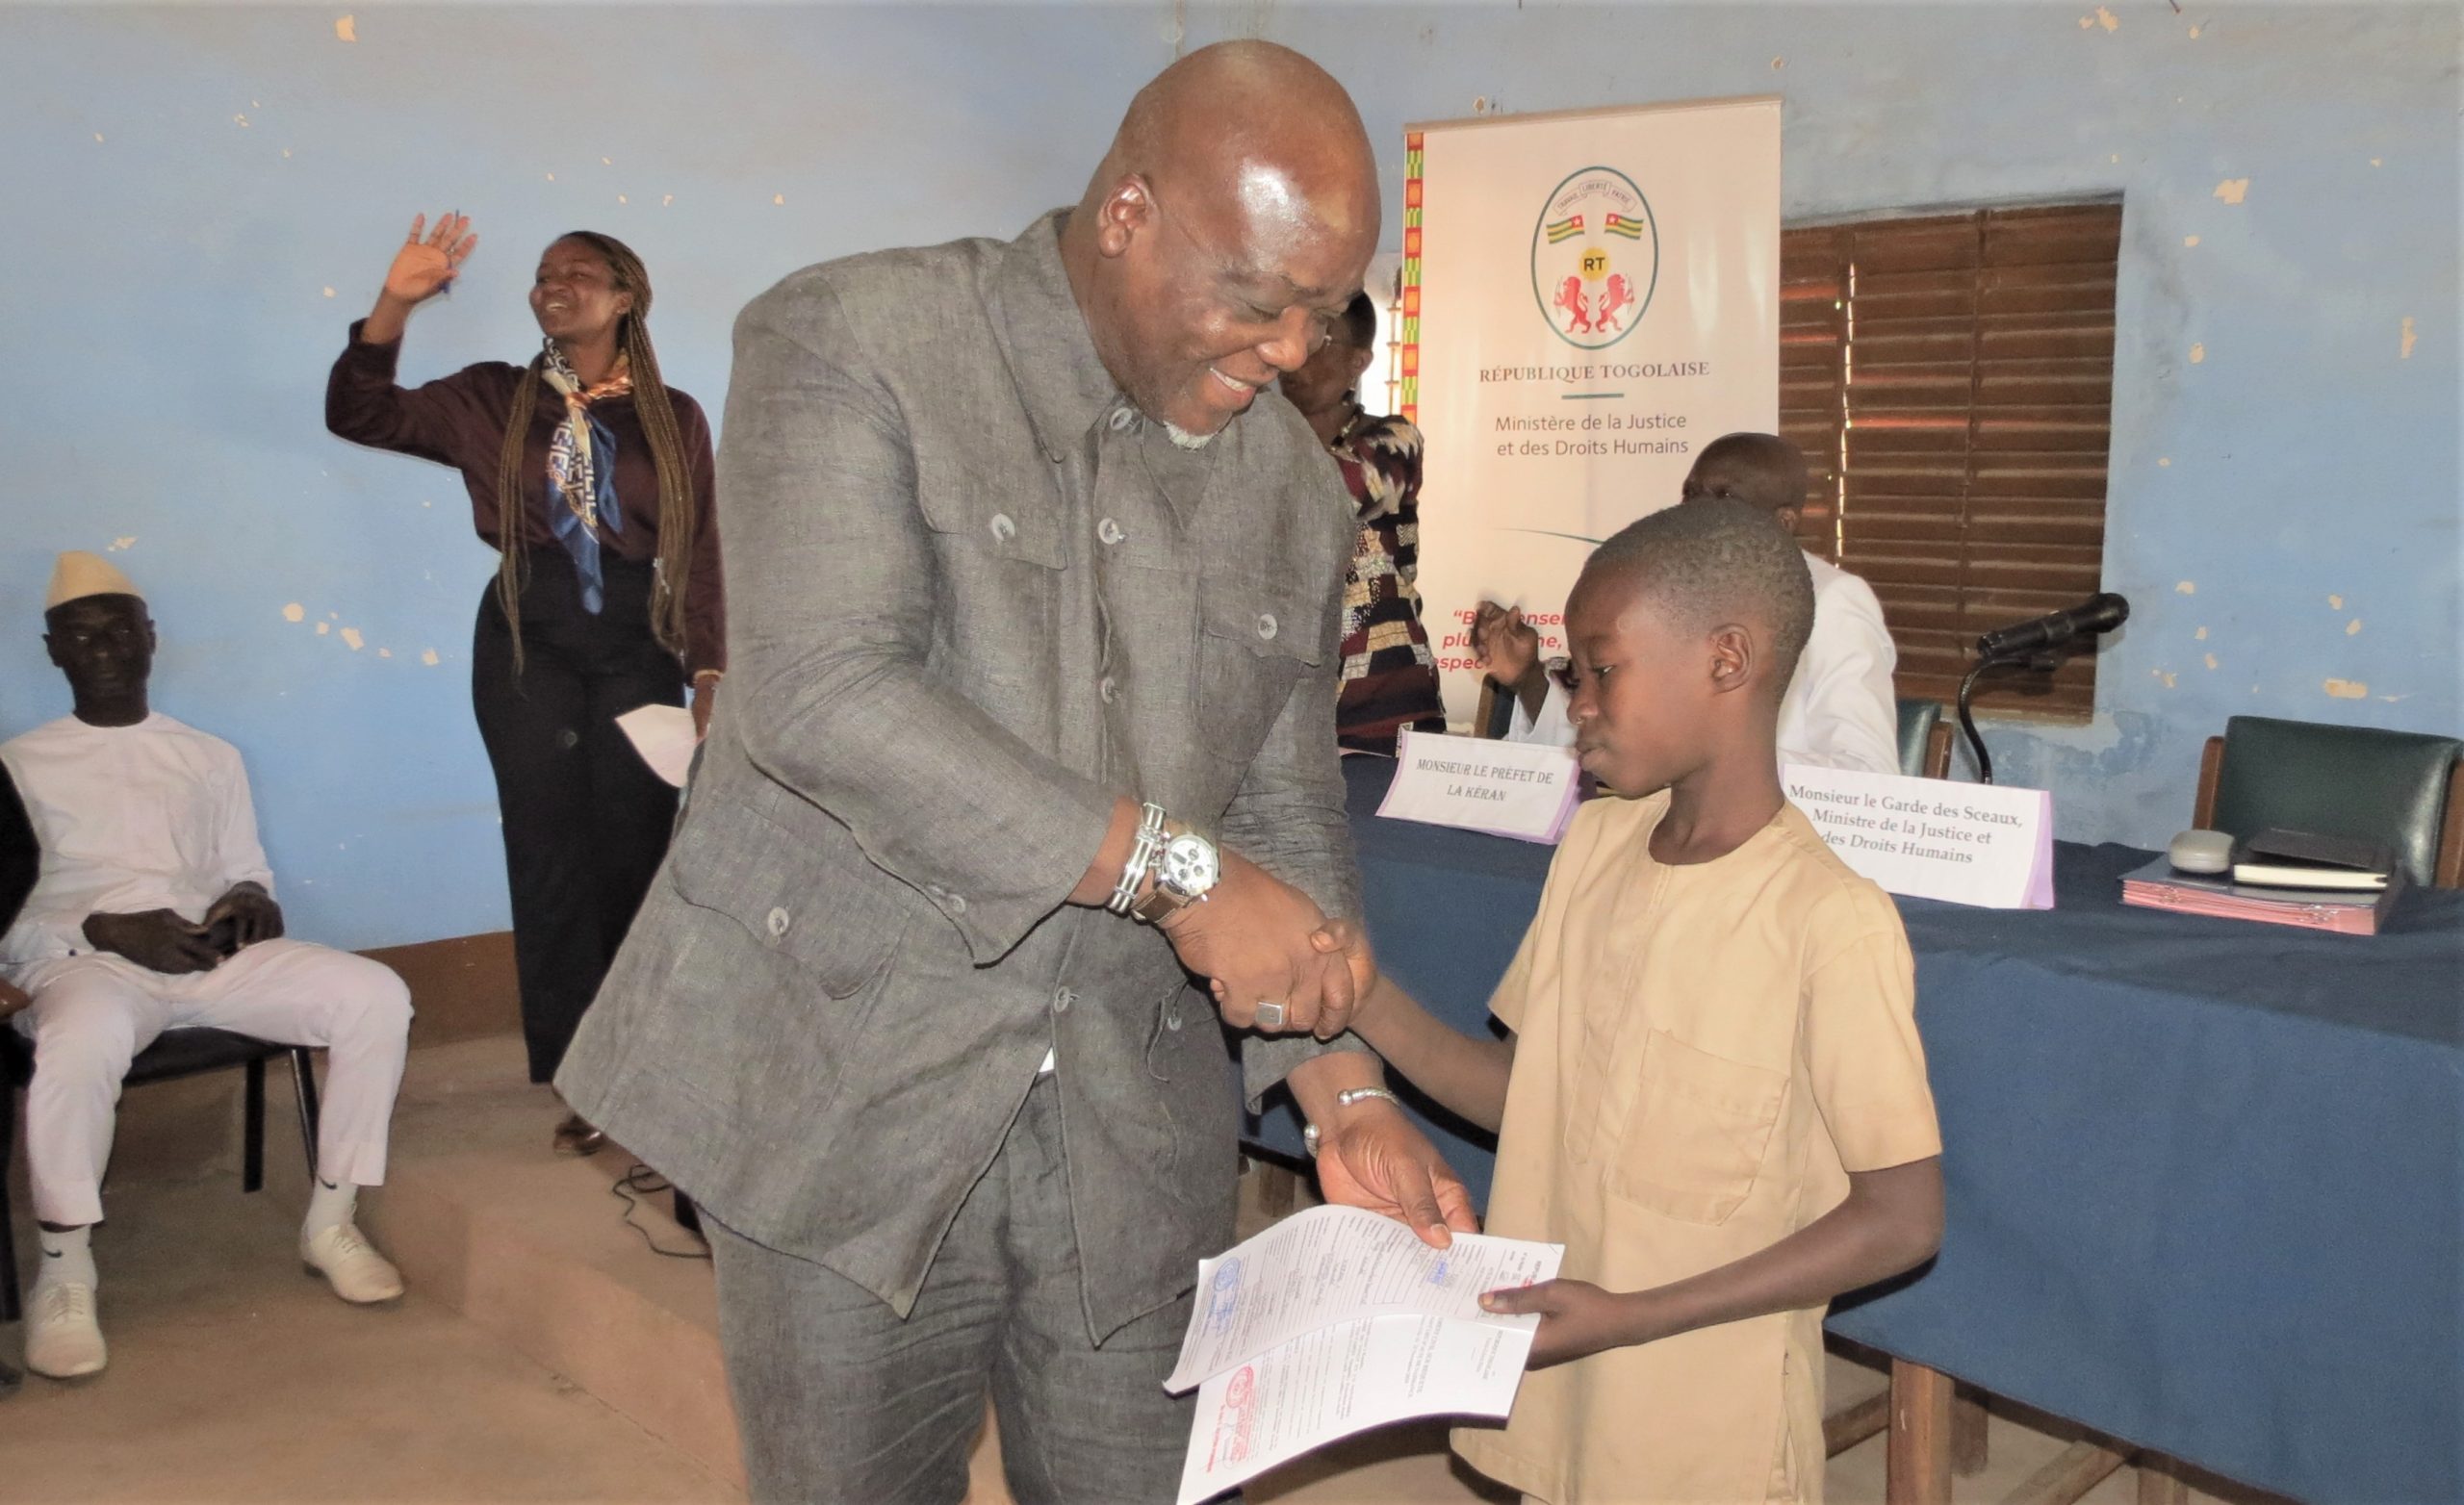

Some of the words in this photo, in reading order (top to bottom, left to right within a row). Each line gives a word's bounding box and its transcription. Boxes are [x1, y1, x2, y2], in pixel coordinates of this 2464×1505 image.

[1583, 257, 1605, 271] RT
[1479, 365, 1595, 384] RÉPUBLIQUE
[1601, 362, 1710, 378] TOGOLAISE
[1495, 416, 1576, 432] Ministère
[1580, 414, 1603, 431] de
[1607, 413, 1622, 430] la
[1627, 413, 1687, 430] Justice
[1497, 441, 1515, 456] et
[1520, 440, 1550, 456] des
[1555, 439, 1608, 456] Droits
[1613, 438, 1689, 455] Humains
[1416, 758, 1472, 776] MONSIEUR
[1474, 765, 1489, 778] LE
[1490, 766, 1535, 782] PRÉFET
[1537, 771, 1554, 784] DE
[1447, 784, 1463, 797] LA
[1464, 785, 1508, 802] KÉRAN
[1789, 784, 1861, 806] Monsieur
[1863, 793, 1878, 808] le
[1882, 796, 1929, 815] Garde
[1933, 803, 1960, 818] des
[1964, 805, 2023, 829] Sceaux,
[1812, 808, 1877, 829] Ministre
[1880, 817, 1898, 832] de
[1902, 819, 1916, 834] la
[1919, 822, 1973, 842] Justice
[1976, 831, 1992, 845] et
[1821, 830, 1846, 846] des
[1850, 833, 1898, 854] Droits
[1901, 841, 1973, 863] Humains
